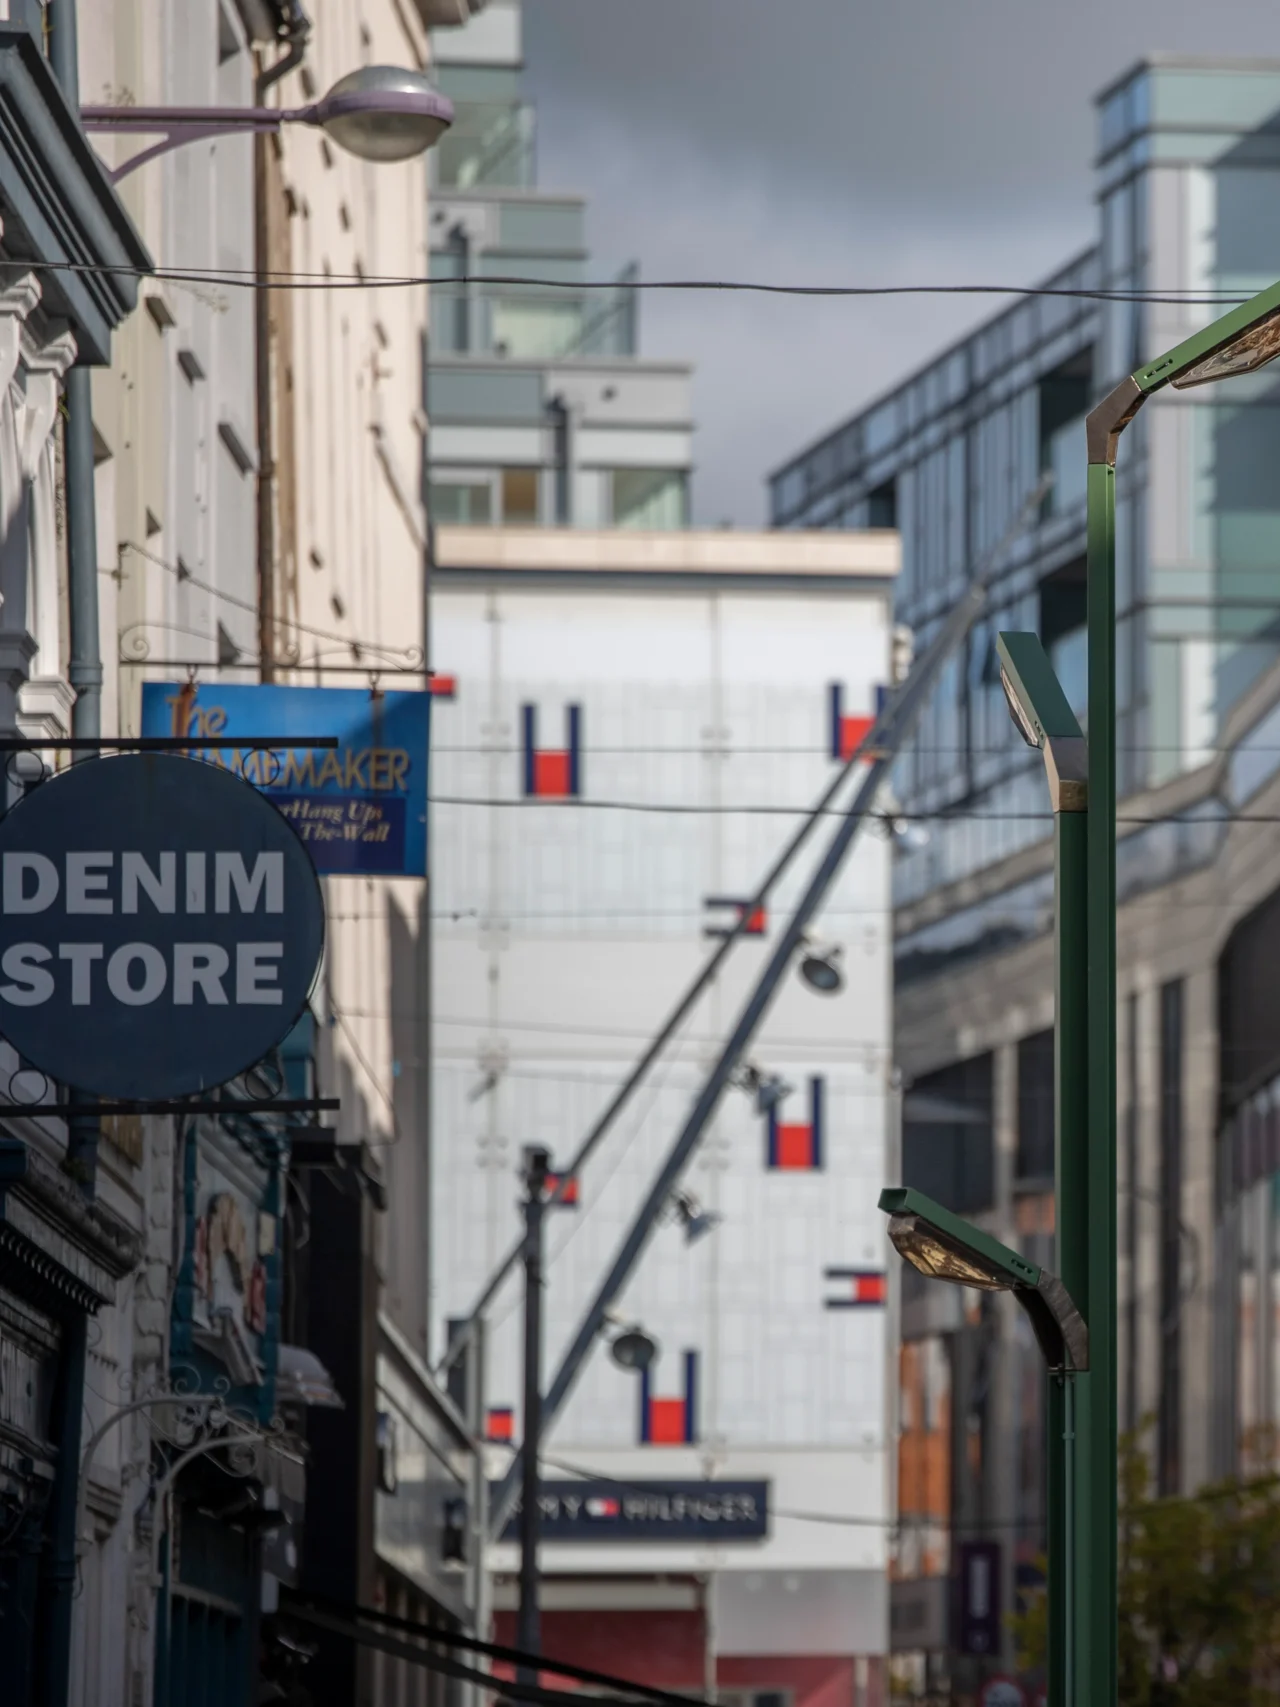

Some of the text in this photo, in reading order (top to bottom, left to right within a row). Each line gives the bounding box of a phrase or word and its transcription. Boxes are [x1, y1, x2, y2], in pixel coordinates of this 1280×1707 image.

[166, 695, 227, 742] The
[348, 799, 383, 825] Ups
[2, 851, 285, 915] DENIM
[0, 942, 284, 1007] STORE
[622, 1492, 758, 1521] HILFIGER
